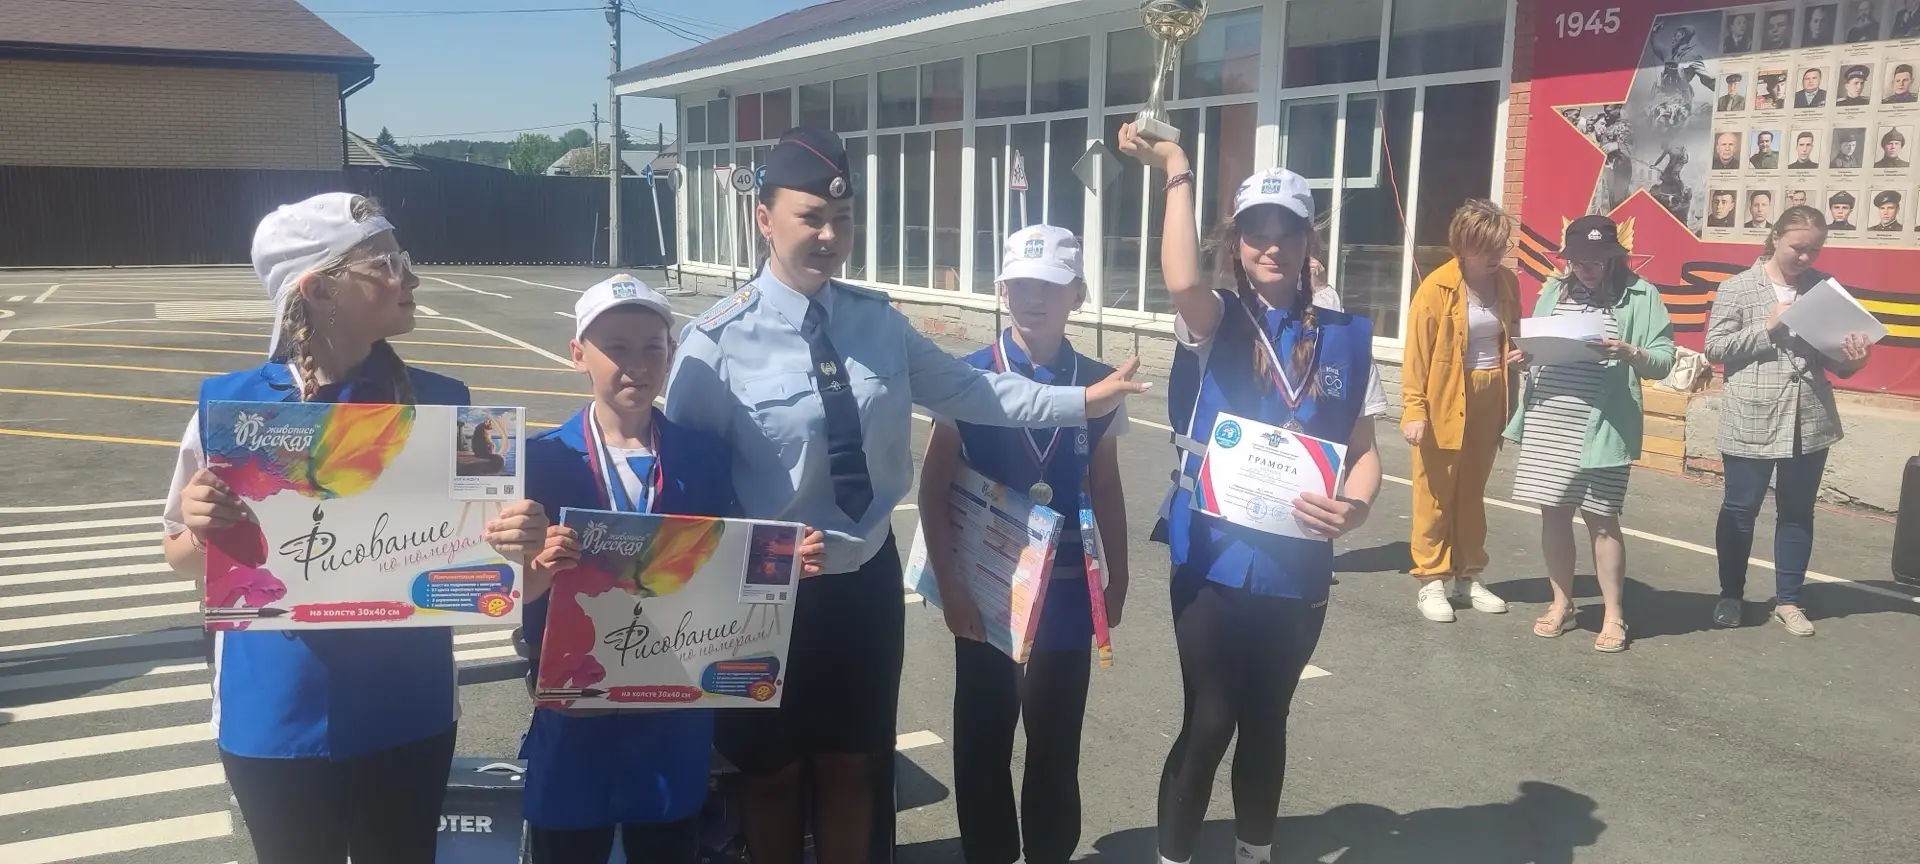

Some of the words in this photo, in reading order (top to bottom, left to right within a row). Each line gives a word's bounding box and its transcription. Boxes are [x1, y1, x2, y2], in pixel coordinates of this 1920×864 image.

[1556, 8, 1620, 38] 1945
[737, 175, 751, 184] 40
[235, 417, 312, 452] Русская
[266, 424, 314, 434] живопись
[1248, 454, 1297, 475] ГРАМОТА
[279, 505, 454, 581] Рисование
[582, 524, 643, 556] Русская
[309, 609, 321, 617] на
[323, 609, 356, 617] холсте
[604, 602, 741, 666] Рисование
